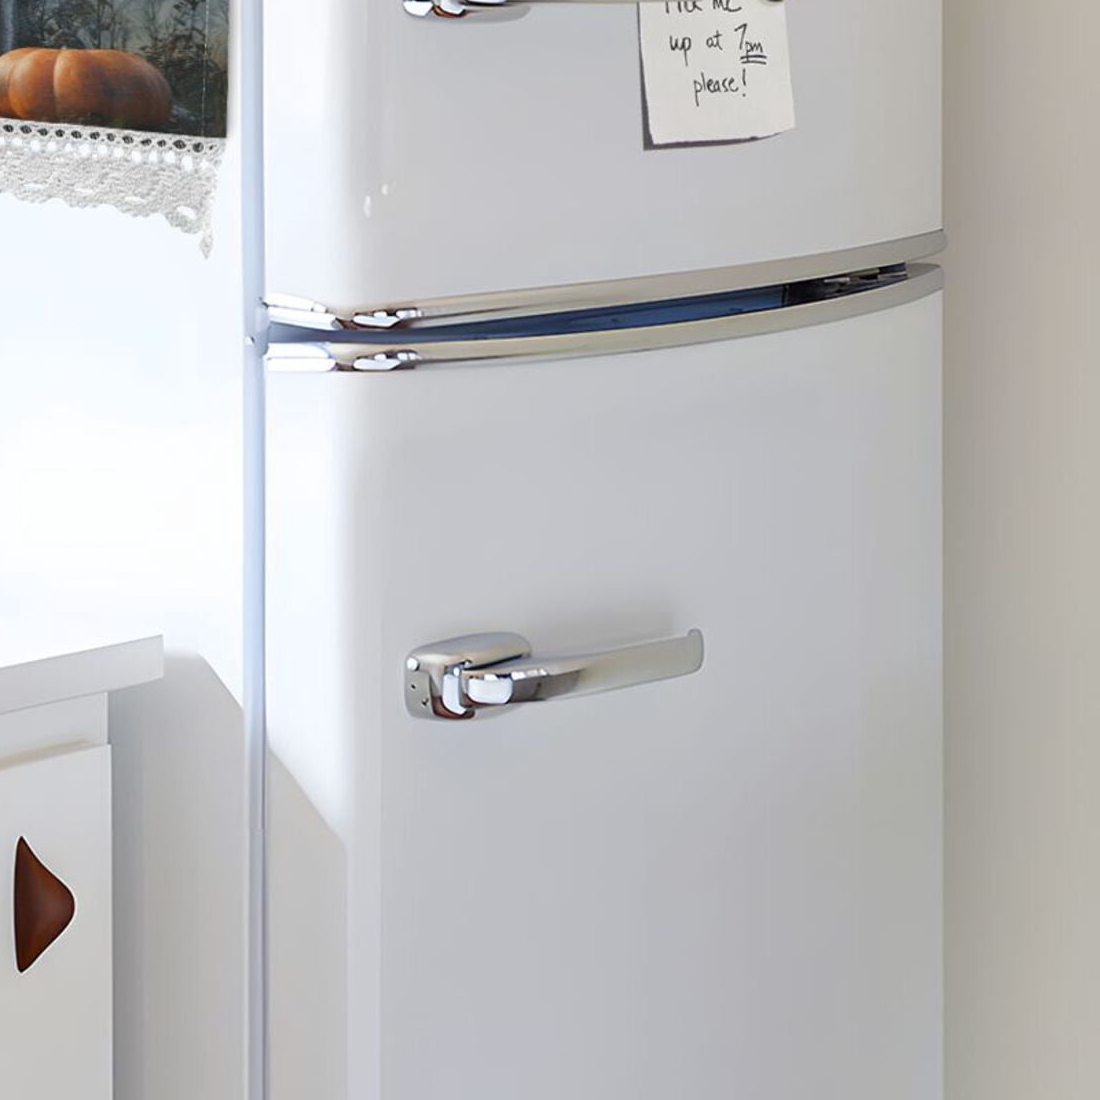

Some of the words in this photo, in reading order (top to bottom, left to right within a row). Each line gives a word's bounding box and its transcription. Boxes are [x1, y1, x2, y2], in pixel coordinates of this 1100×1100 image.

[669, 35, 692, 67] up
[706, 29, 723, 51] at
[693, 68, 746, 107] please!
